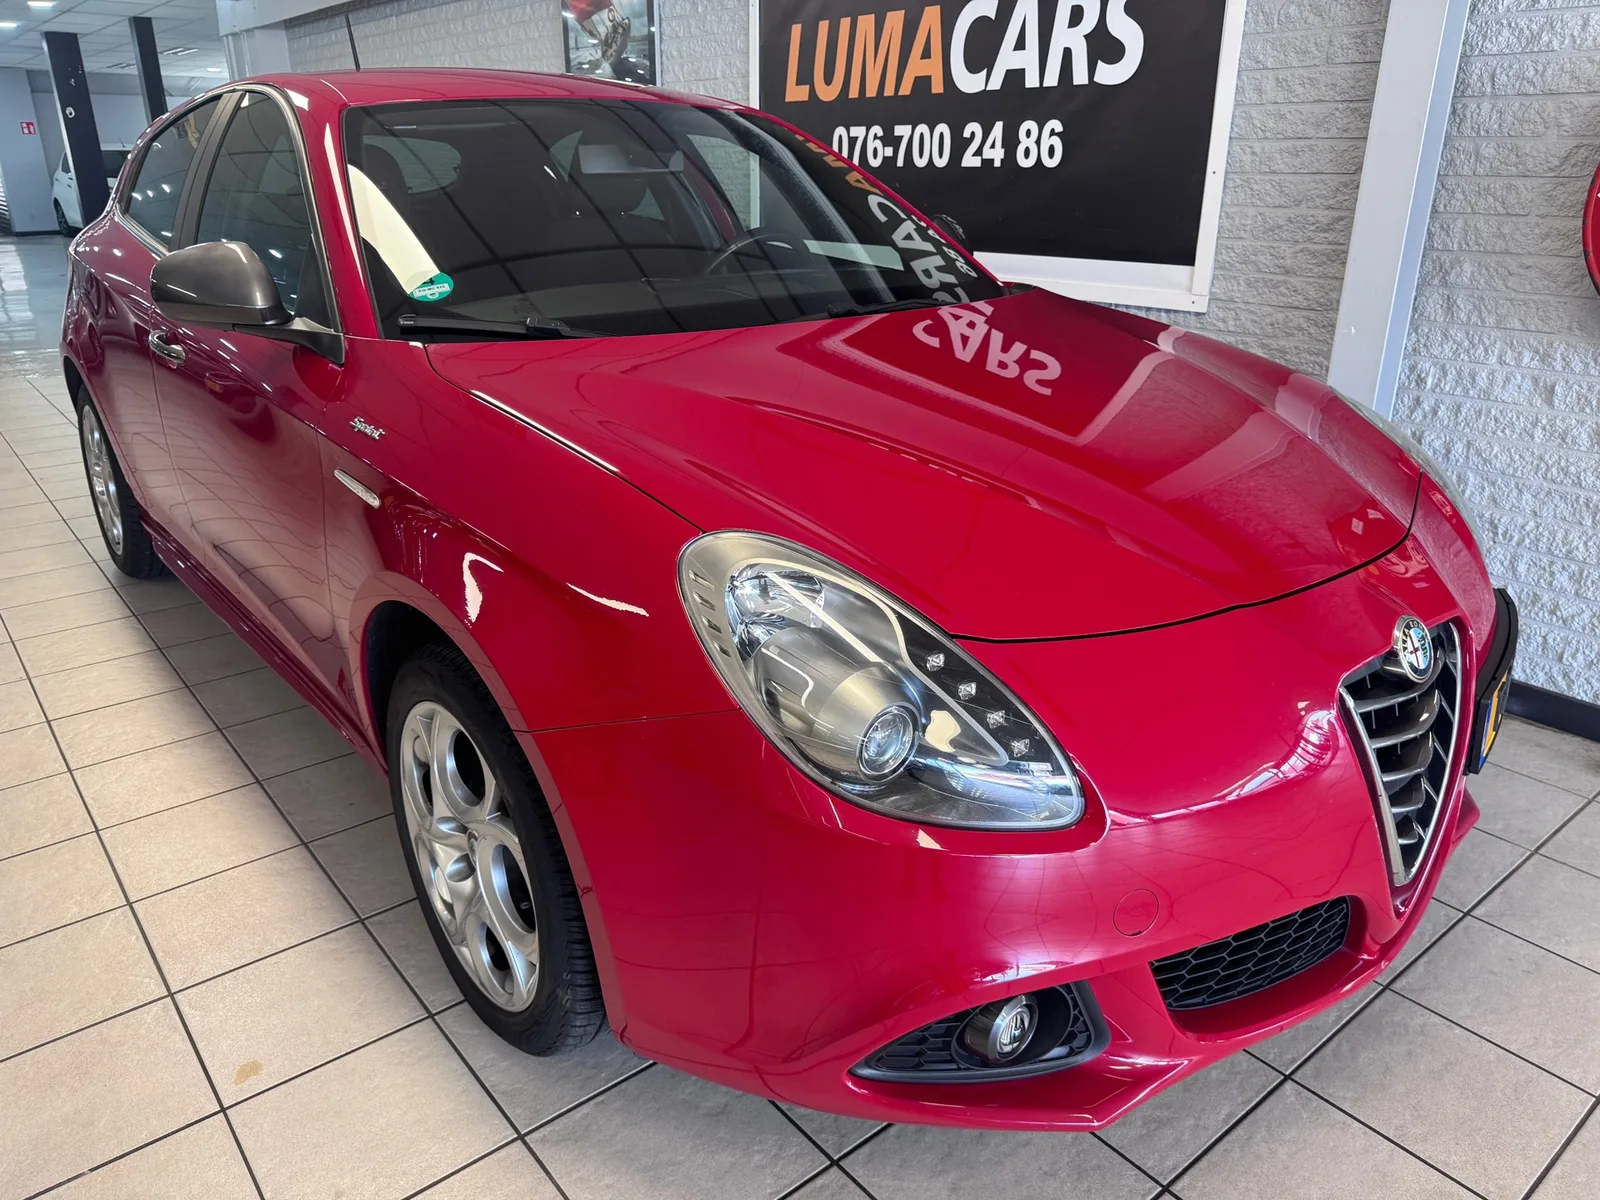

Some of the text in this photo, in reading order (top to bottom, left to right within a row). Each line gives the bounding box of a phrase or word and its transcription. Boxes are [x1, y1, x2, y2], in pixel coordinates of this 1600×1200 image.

[785, 0, 1144, 102] LUMACARS
[832, 119, 1064, 168] 076-700 24 86
